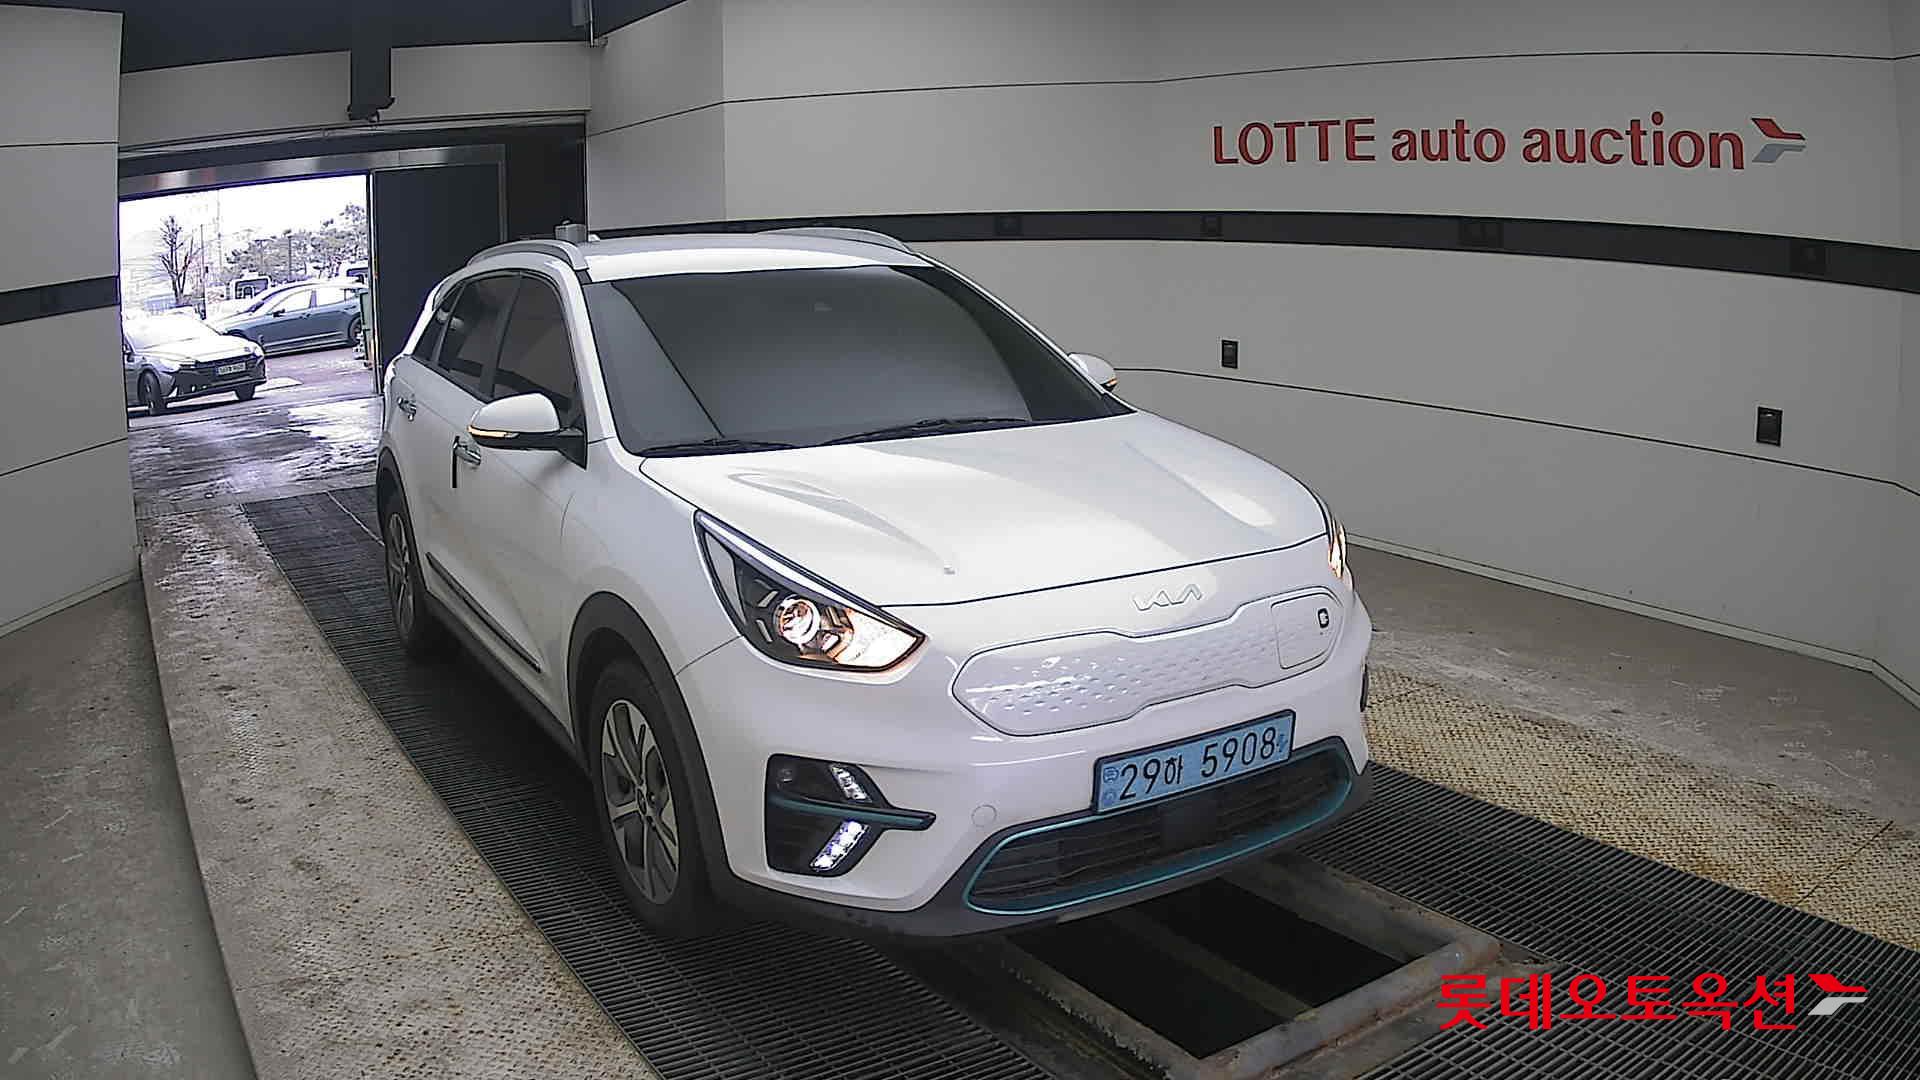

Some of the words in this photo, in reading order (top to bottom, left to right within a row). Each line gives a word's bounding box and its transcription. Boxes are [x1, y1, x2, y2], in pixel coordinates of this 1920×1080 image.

[1212, 118, 1376, 165] LOTTE
[1391, 118, 1506, 163] auto
[1522, 111, 1745, 170] auction
[1119, 754, 1183, 801] 29하
[1200, 726, 1277, 778] 5908
